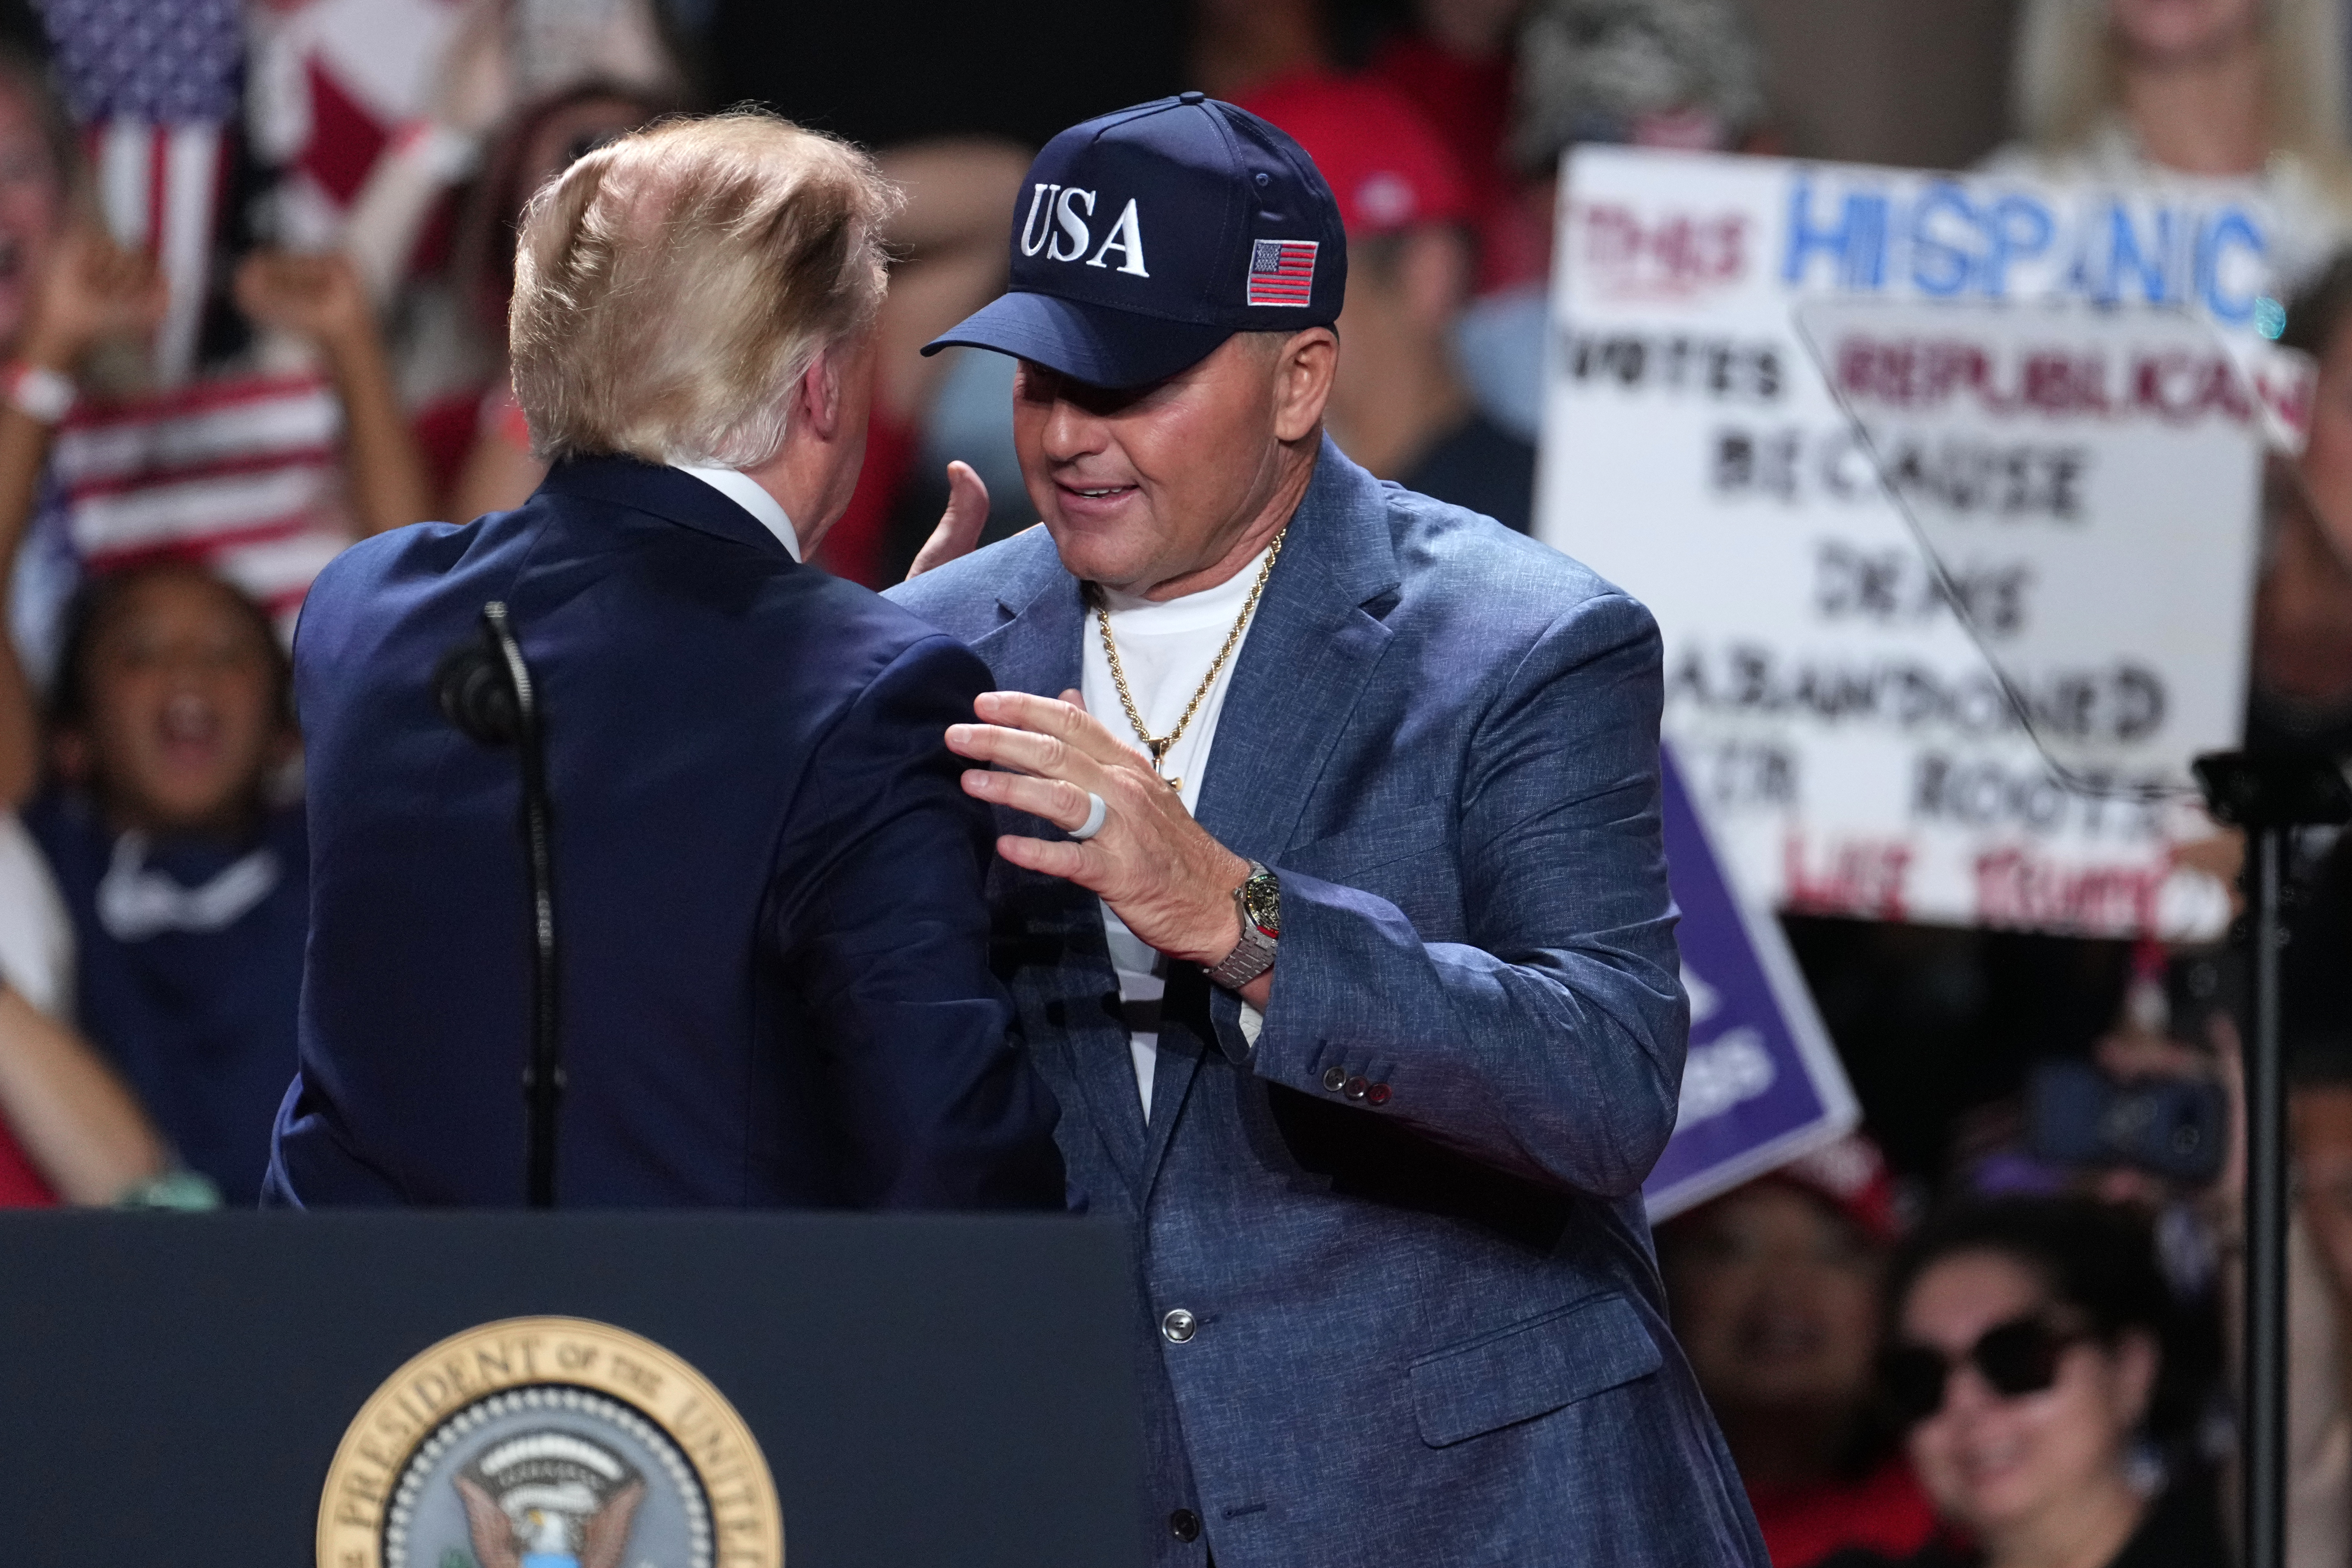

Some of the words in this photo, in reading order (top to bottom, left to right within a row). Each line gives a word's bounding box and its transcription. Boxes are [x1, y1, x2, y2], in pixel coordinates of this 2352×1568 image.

[1020, 183, 1150, 278] USA
[1583, 201, 1751, 282] THIS
[1779, 173, 2267, 325] HISPANIC
[1562, 327, 1783, 399] VOTES
[1835, 335, 2309, 434] REPUBLICAN
[1710, 428, 2092, 521] BECAUSE
[1676, 644, 2170, 742] ABANDONED
[334, 1338, 540, 1527] PRESIDENT
[557, 1343, 598, 1373] OF
